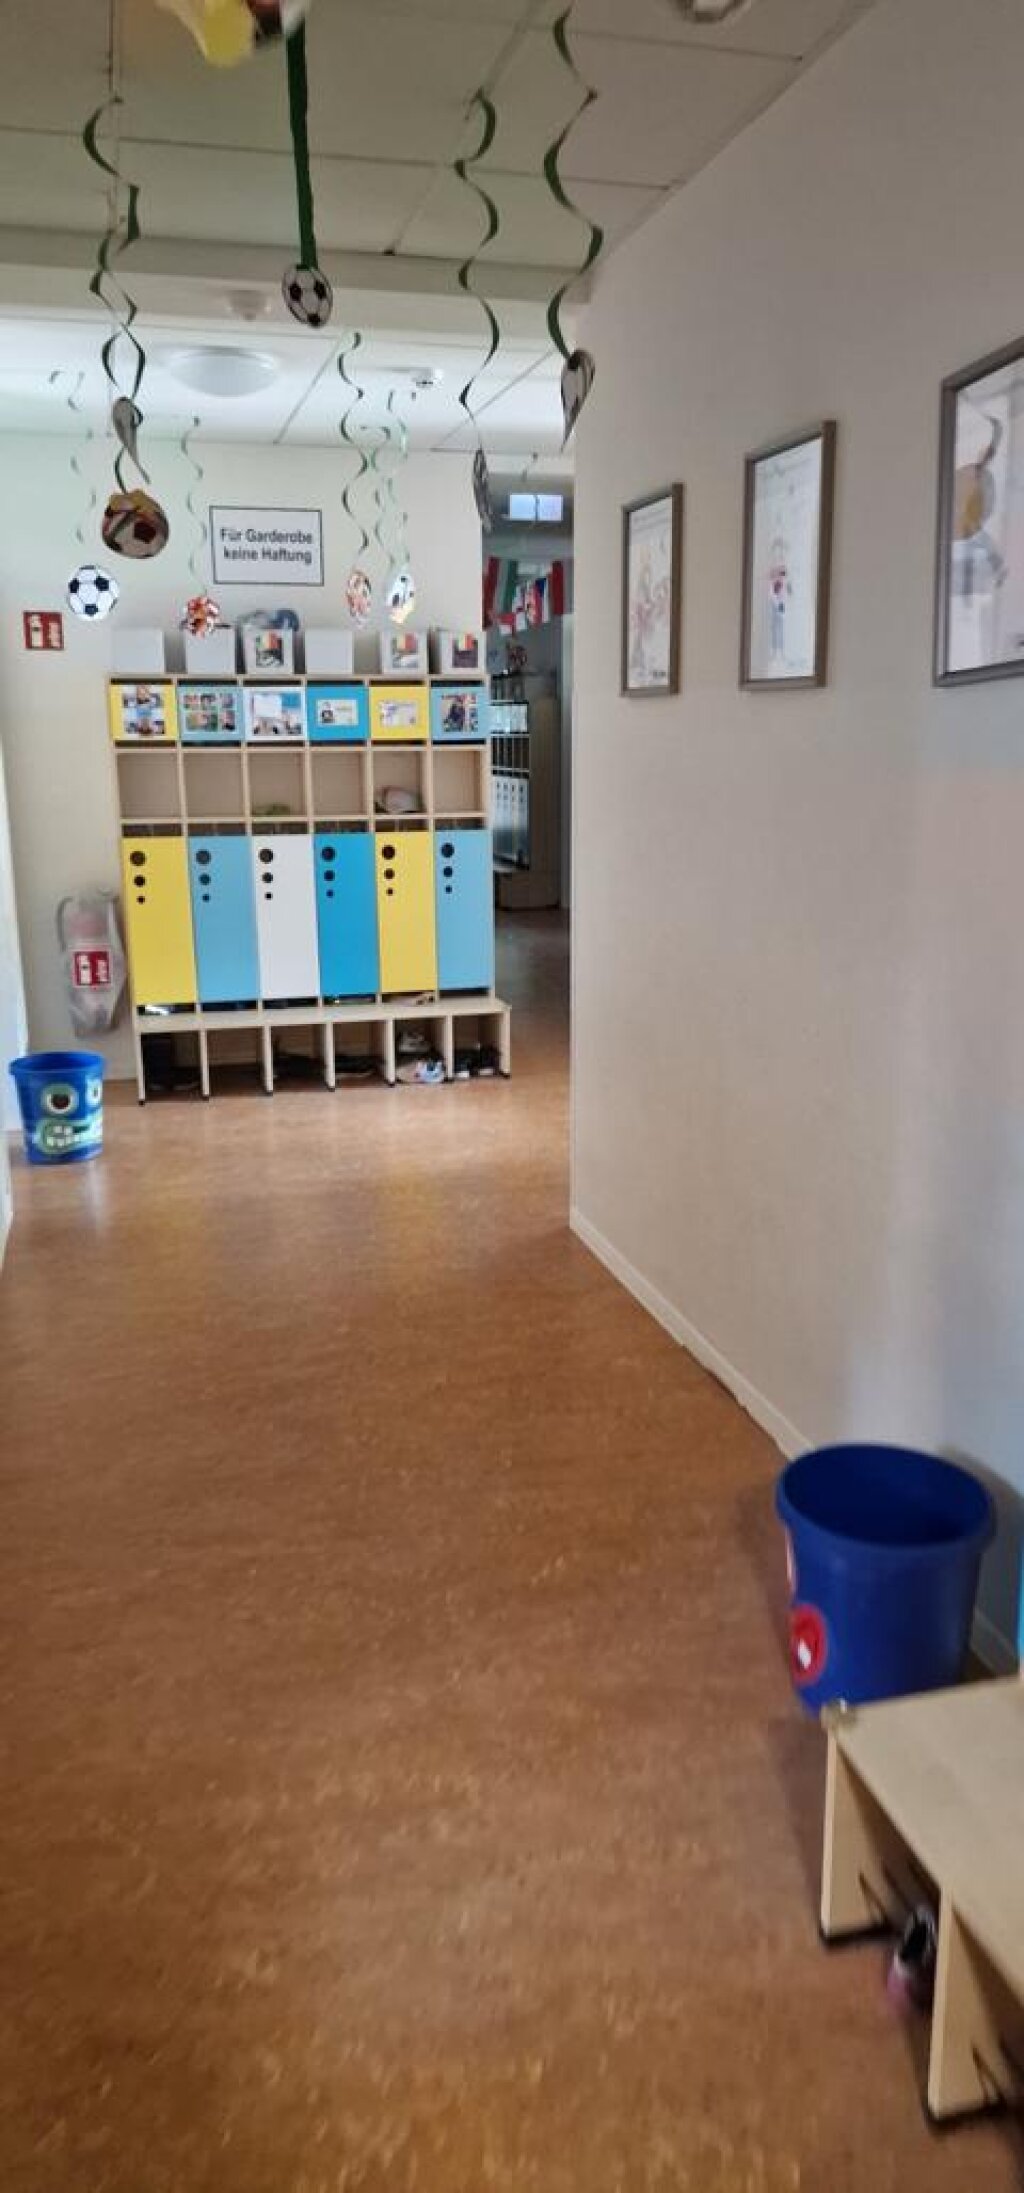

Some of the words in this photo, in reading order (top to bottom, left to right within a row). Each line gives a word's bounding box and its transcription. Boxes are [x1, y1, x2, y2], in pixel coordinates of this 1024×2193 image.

[220, 526, 242, 541] Für
[245, 528, 312, 544] Garderobe
[223, 546, 259, 560] keine
[261, 547, 312, 565] Haftung
